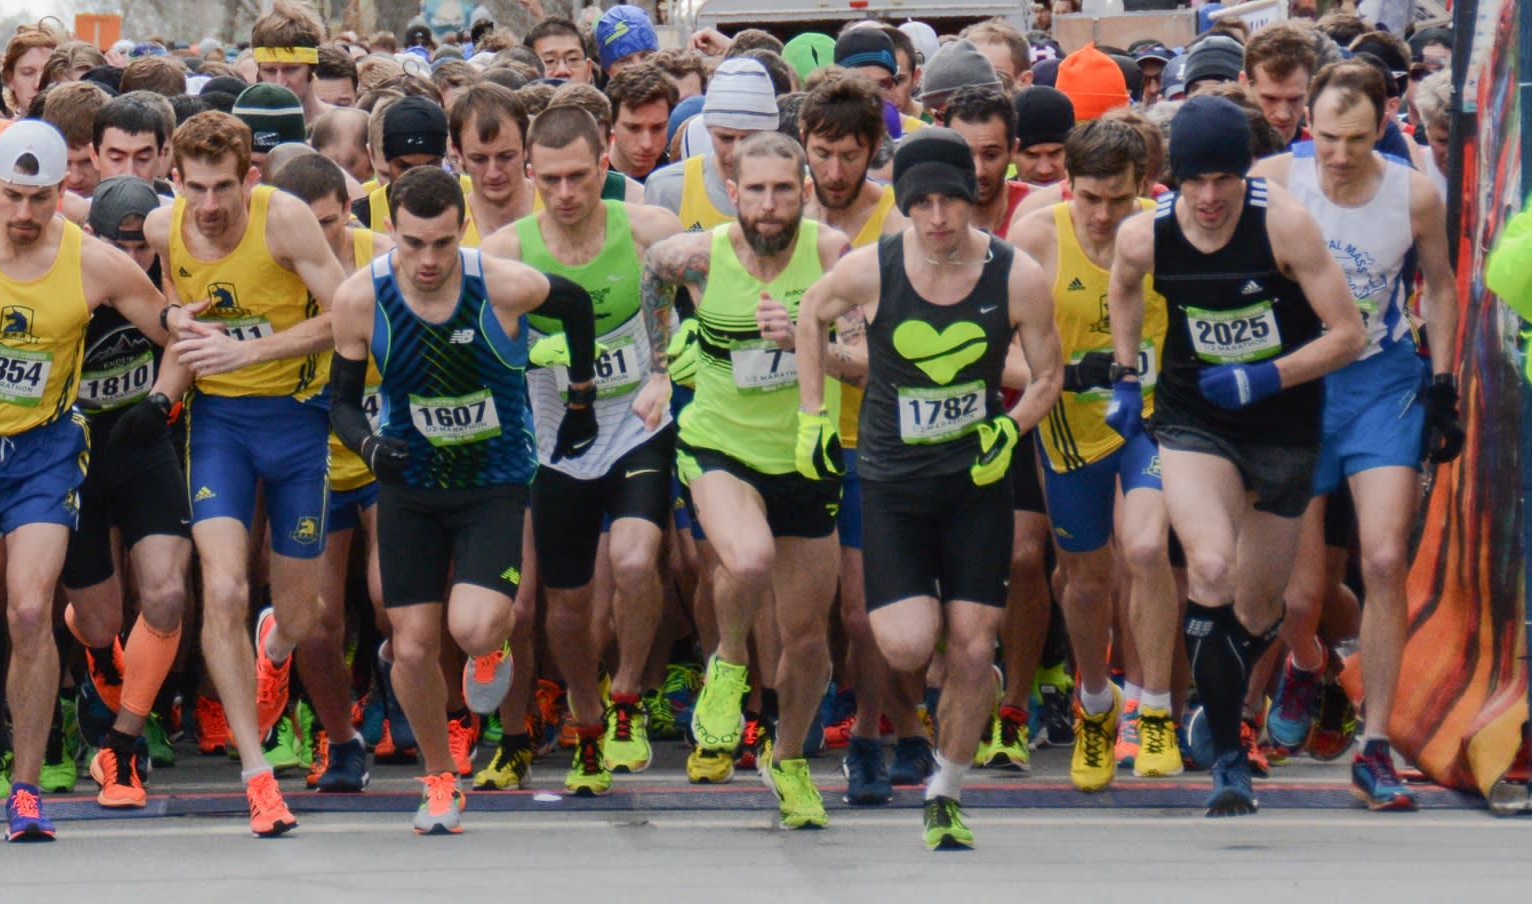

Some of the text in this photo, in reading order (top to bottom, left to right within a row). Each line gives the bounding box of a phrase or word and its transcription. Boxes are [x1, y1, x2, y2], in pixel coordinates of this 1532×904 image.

[1344, 244, 1369, 273] MASS
[1195, 315, 1269, 346] 2025
[88, 365, 149, 399] 1810
[418, 401, 487, 428] 1607
[909, 393, 979, 425] 1782
